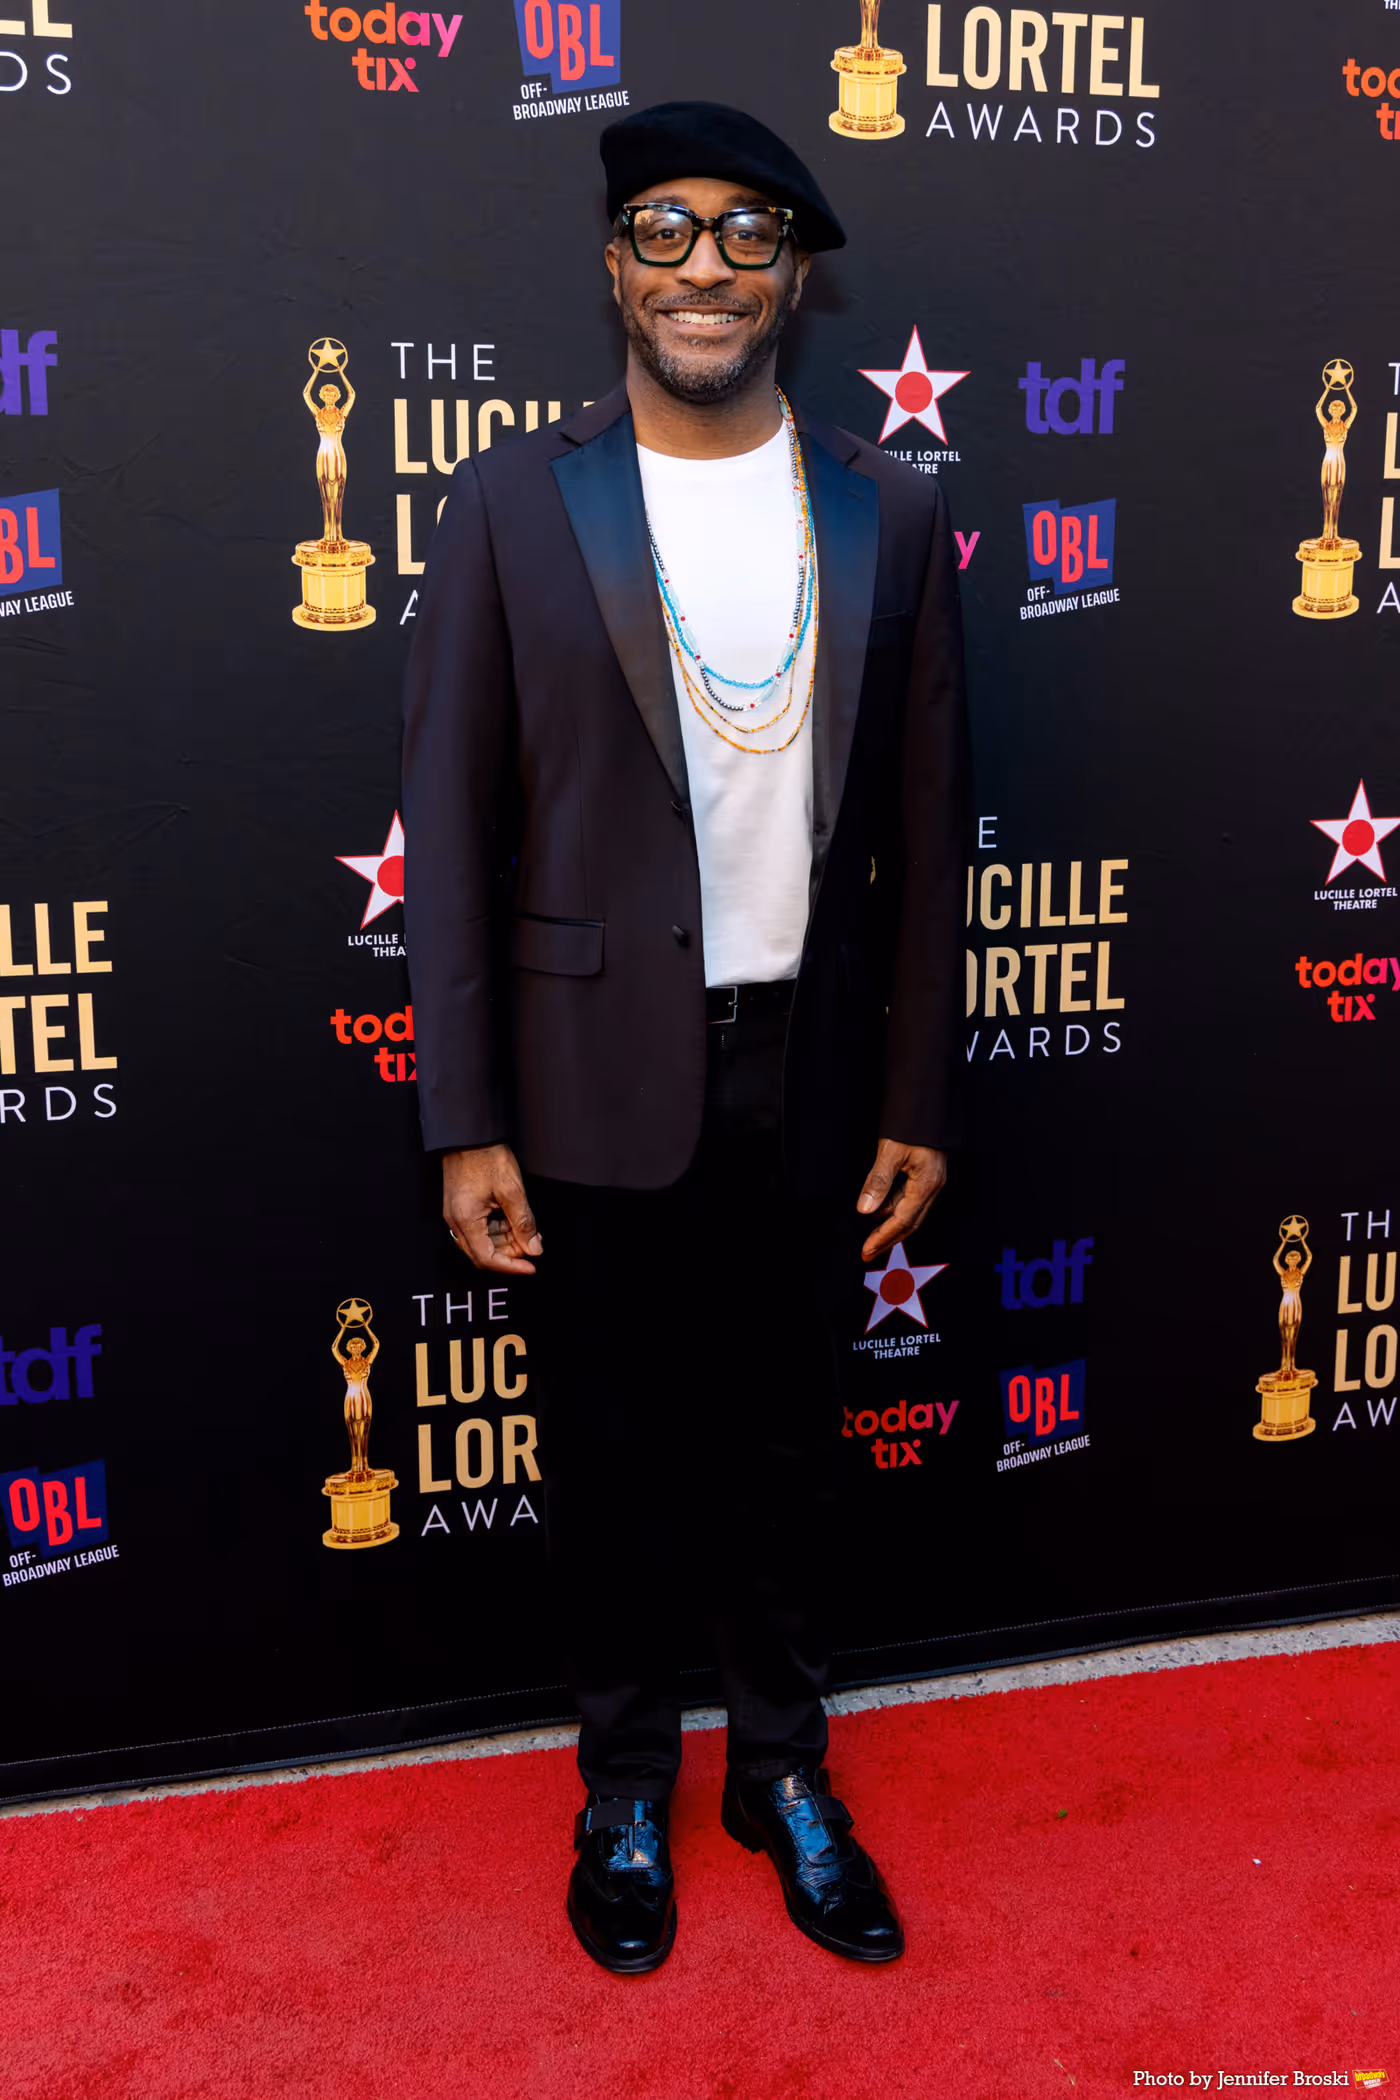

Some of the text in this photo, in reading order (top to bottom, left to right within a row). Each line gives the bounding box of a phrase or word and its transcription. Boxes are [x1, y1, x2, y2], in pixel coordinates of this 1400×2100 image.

[305, 0, 463, 58] today
[524, 0, 614, 80] OBL
[927, 4, 1159, 98] LORTEL
[352, 48, 419, 92] tix
[1343, 59, 1400, 98] to
[513, 91, 629, 120] BROADWAY LEAGUE
[521, 83, 547, 99] OFF-
[926, 102, 1155, 147] AWARDS
[391, 343, 495, 380] THE
[1019, 359, 1125, 434] tdf
[394, 399, 595, 474] LUC
[912, 464, 937, 473] TRE
[918, 451, 960, 461] LORTEL
[1033, 511, 1108, 583] OBL
[25, 591, 74, 612] LEAGUE
[1020, 589, 1120, 619] BROADWAY LEAGUE
[1027, 586, 1050, 601] OFF-
[967, 859, 1128, 930] CILLE
[1315, 888, 1397, 900] LUCILLE LORTEL
[1334, 899, 1377, 910] THEATRE
[348, 934, 398, 945] LUCILLE
[967, 941, 1124, 1017] RTEL
[1327, 991, 1375, 1022] tix
[967, 1022, 1120, 1062] ARDS
[995, 1238, 1094, 1309] tdf
[412, 1288, 508, 1326] THE
[854, 1333, 940, 1352] LUCILLE LORTEL
[874, 1345, 919, 1359] THEATRE
[842, 1400, 959, 1437] today
[1009, 1374, 1079, 1435] OBL
[871, 1439, 922, 1468] tix
[997, 1435, 1090, 1472] BROADWAY LEAGUE
[1004, 1441, 1026, 1457] OFF-
[9, 1477, 101, 1546] OBL
[3, 1545, 119, 1586] BROADWAY LEAGUE
[10, 1551, 38, 1570] OFF-
